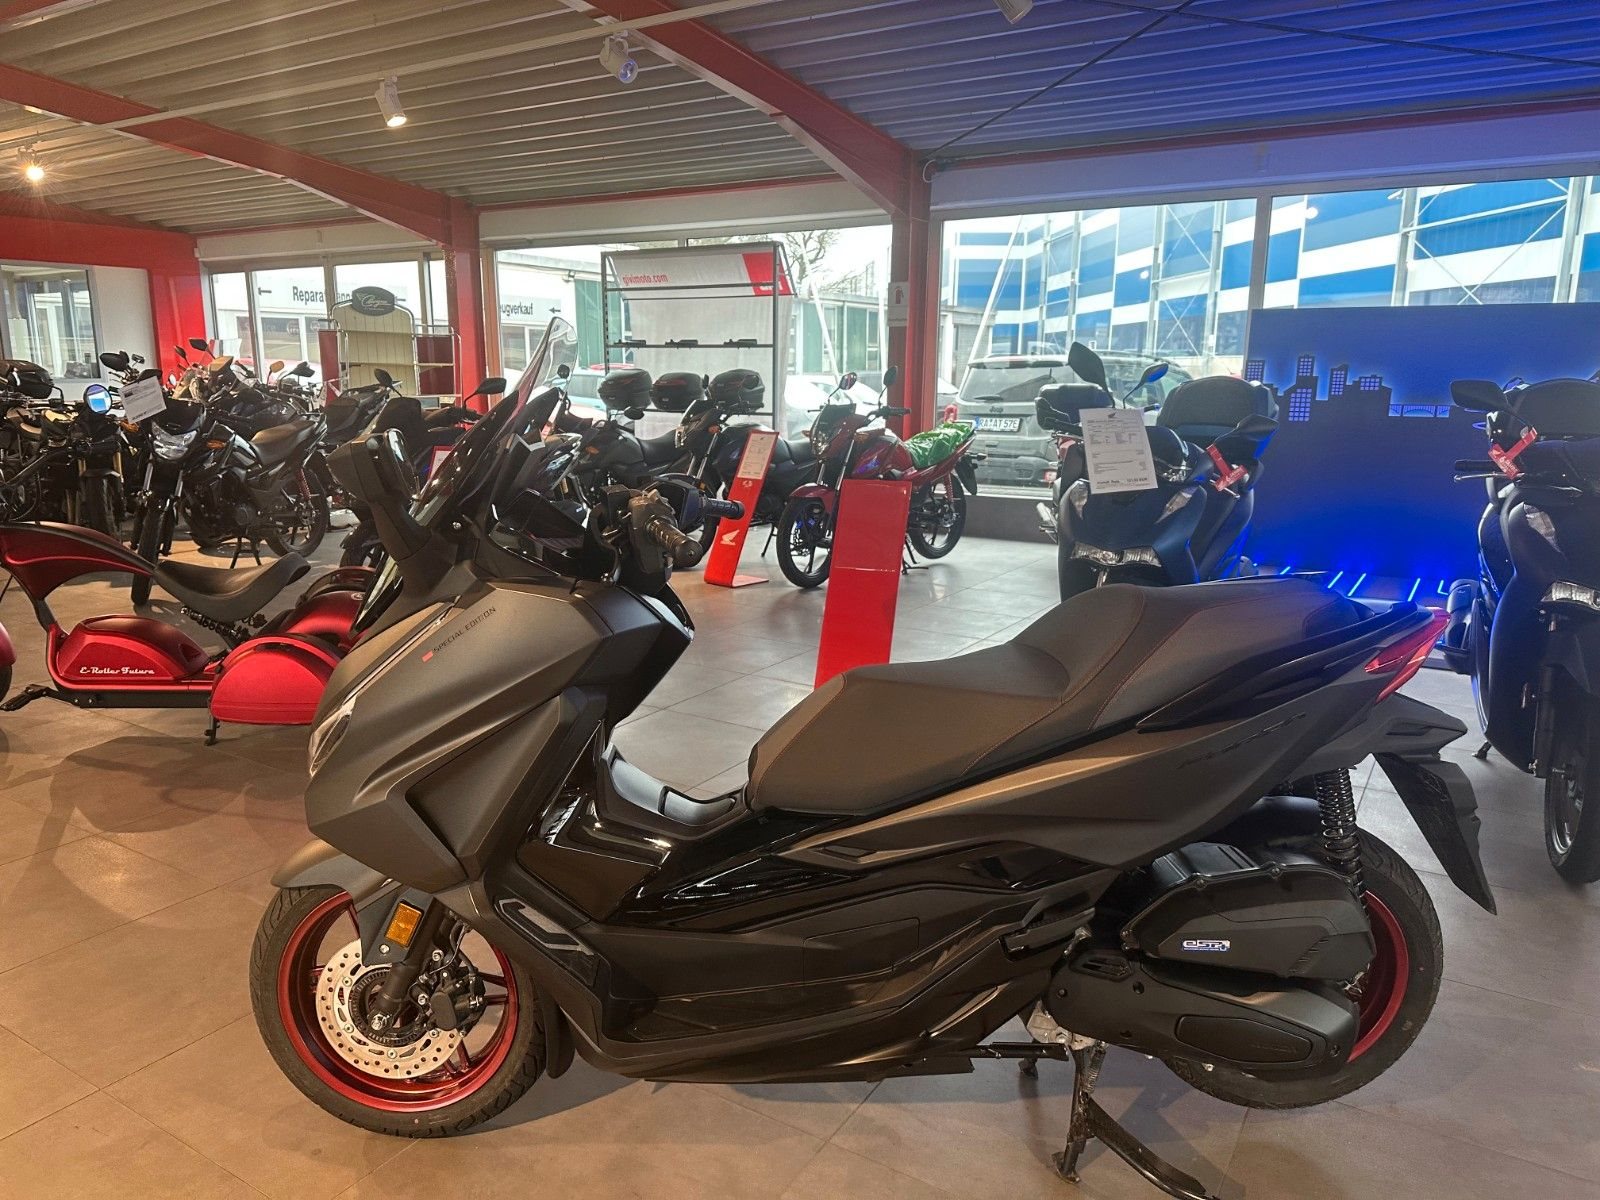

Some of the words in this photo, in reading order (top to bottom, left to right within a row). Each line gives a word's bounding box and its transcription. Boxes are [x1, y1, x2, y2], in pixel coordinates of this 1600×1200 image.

[433, 629, 465, 652] SPECIAL
[464, 606, 497, 631] EDITION
[79, 666, 121, 675] E-Roller
[120, 666, 155, 675] Future
